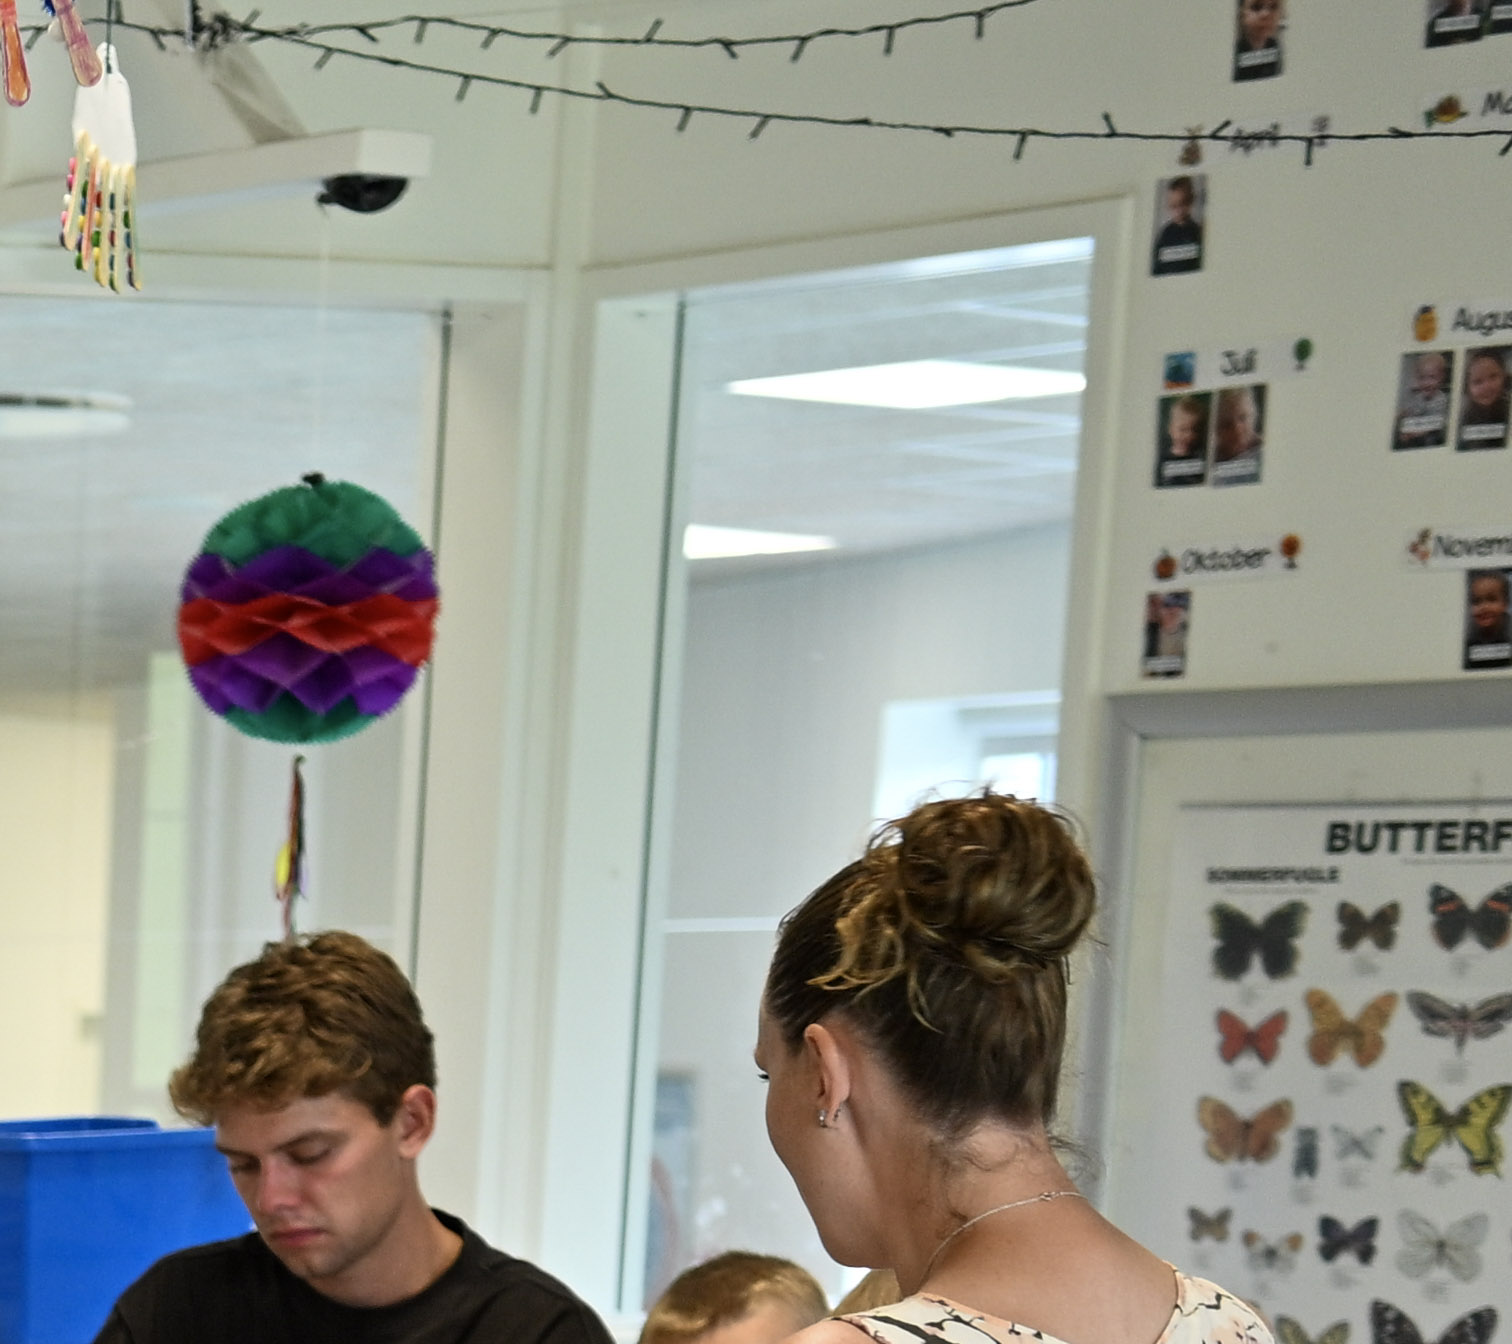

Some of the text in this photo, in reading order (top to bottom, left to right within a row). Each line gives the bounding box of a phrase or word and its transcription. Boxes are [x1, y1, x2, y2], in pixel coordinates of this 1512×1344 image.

[1220, 348, 1257, 377] Juli
[1182, 547, 1271, 575] Oktober
[1326, 820, 1512, 854] BUTTERF
